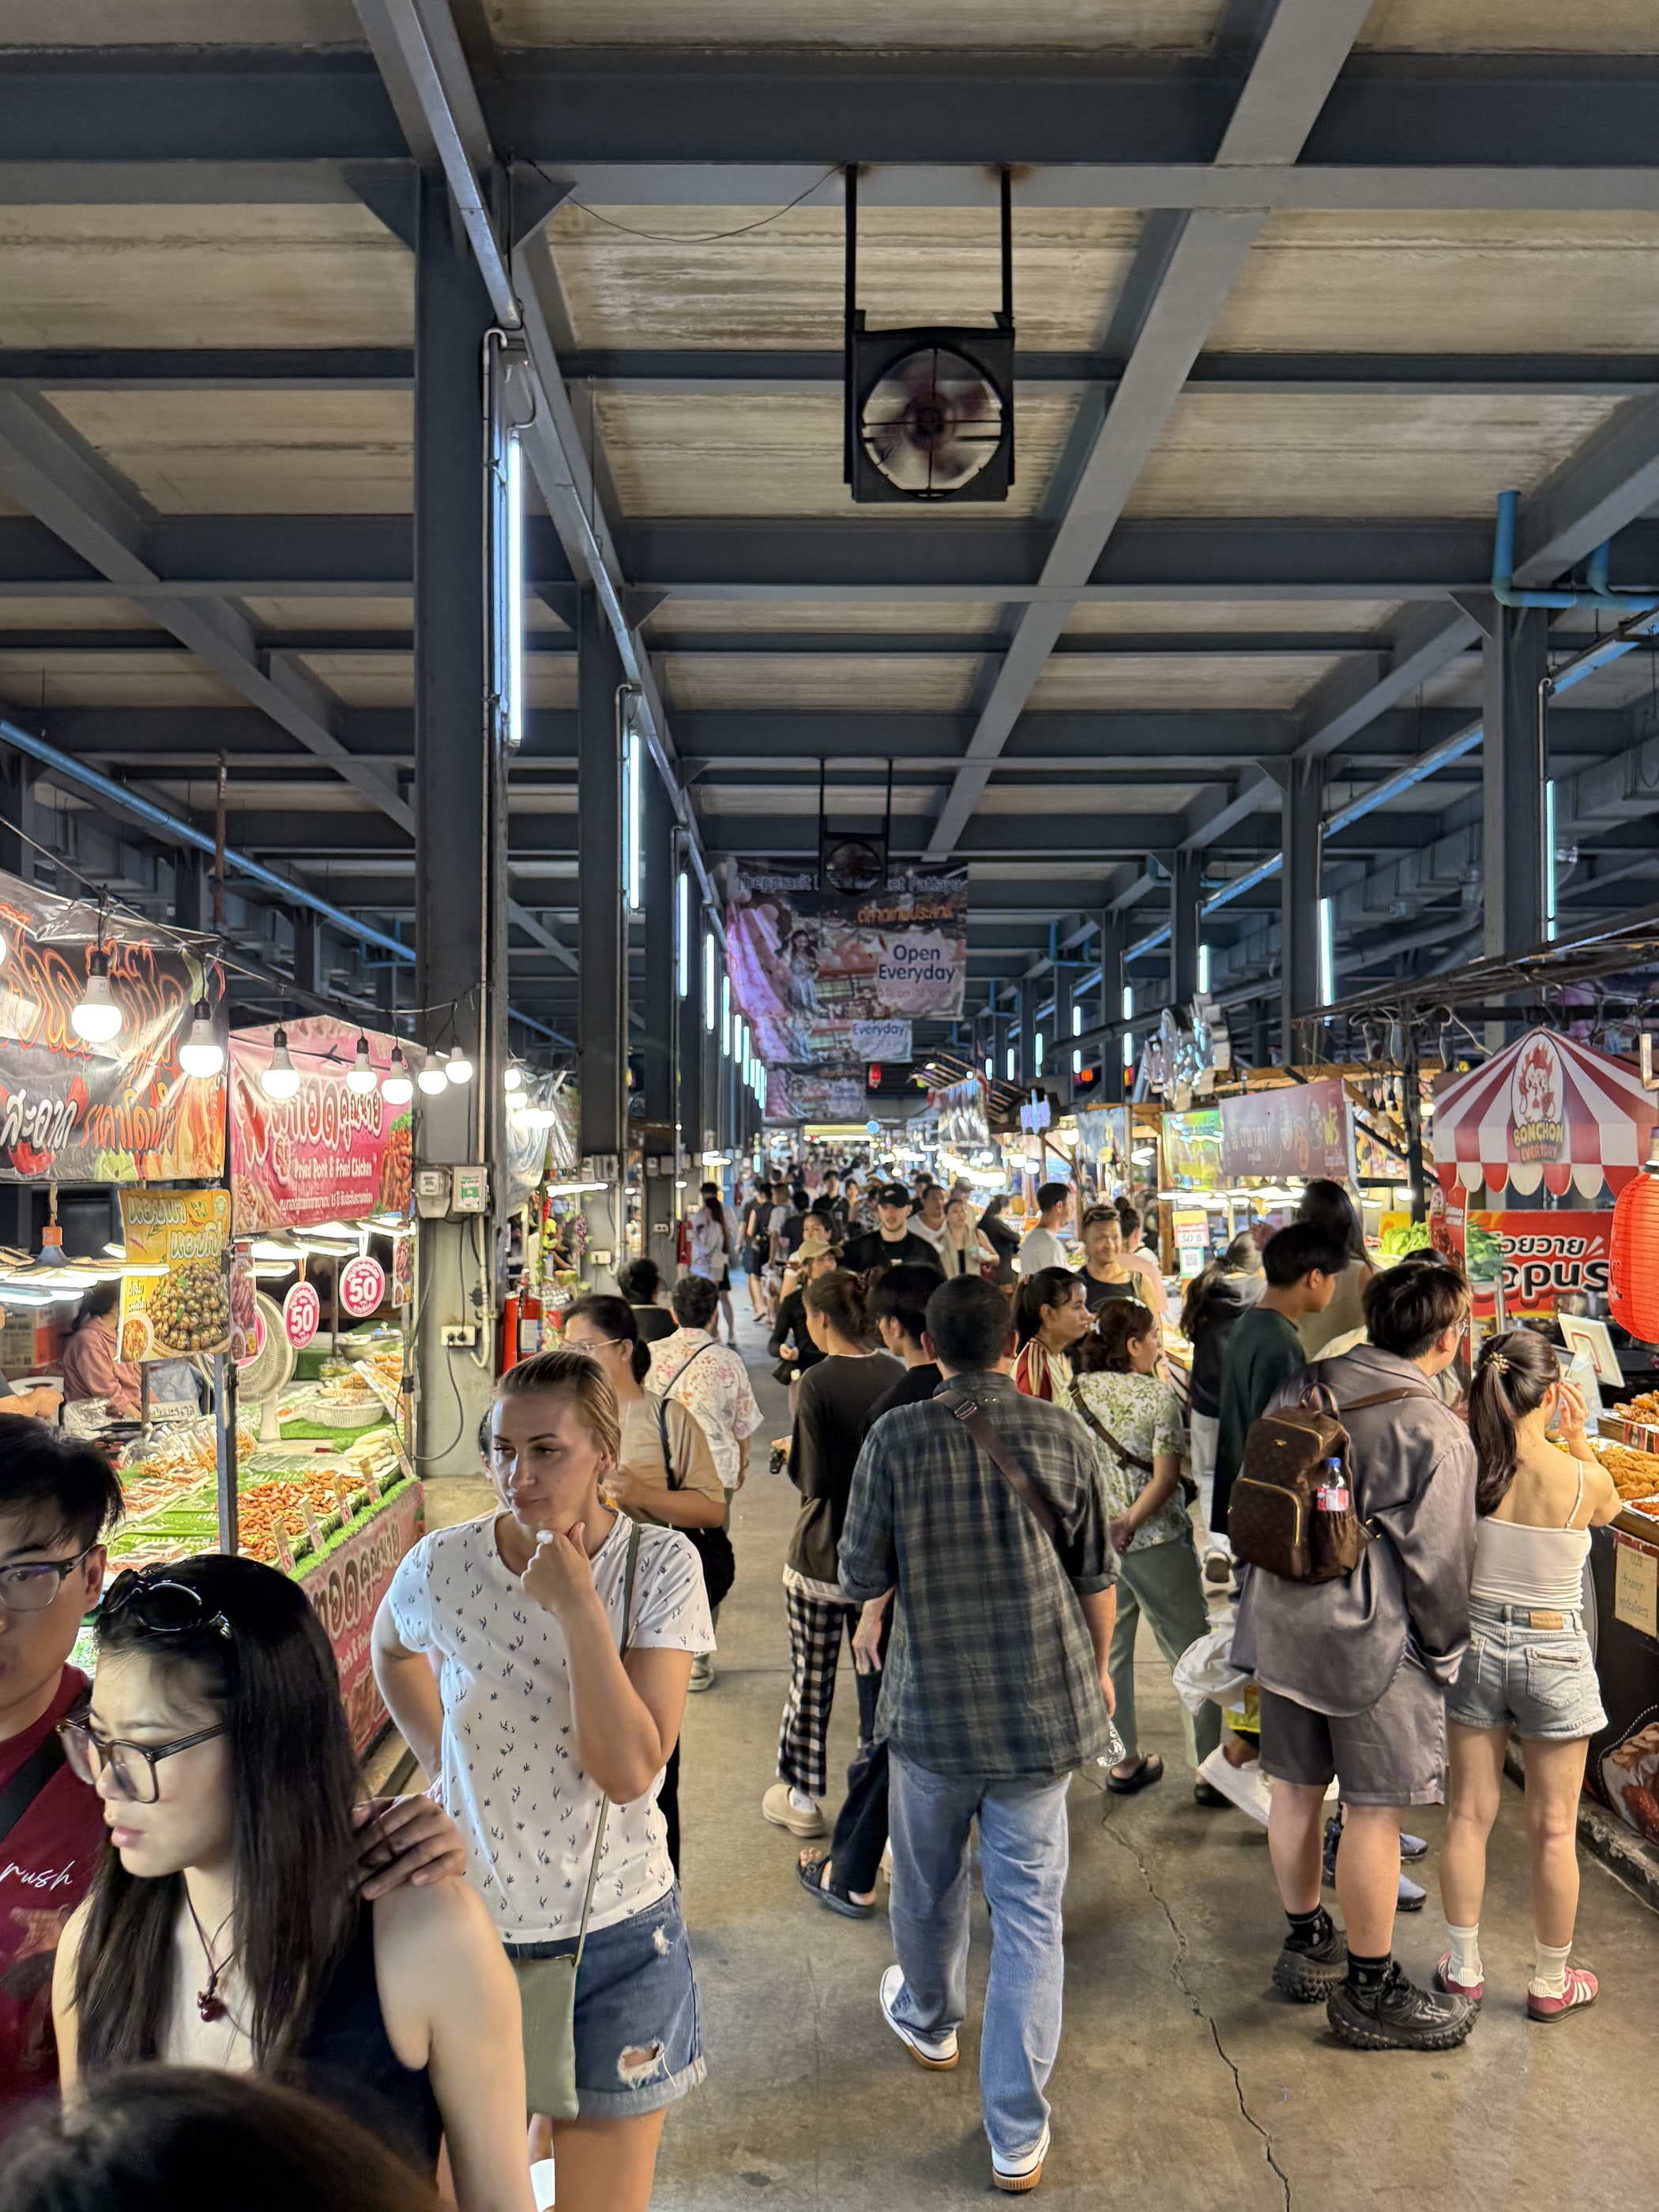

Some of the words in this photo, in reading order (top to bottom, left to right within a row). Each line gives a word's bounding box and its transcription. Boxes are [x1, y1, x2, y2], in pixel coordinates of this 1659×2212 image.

[893, 944, 940, 965] Open
[878, 964, 955, 984] Everyday
[852, 1022, 905, 1036] Everyday
[1513, 1120, 1563, 1147] BONCHON
[313, 1157, 328, 1179] Pork
[335, 1157, 350, 1178] Fried
[352, 1157, 372, 1177] Chicken
[1500, 1236, 1586, 1256] วยวาย
[349, 1276, 378, 1304] 50
[1501, 1262, 1610, 1297] opus
[290, 1304, 314, 1334] 50
